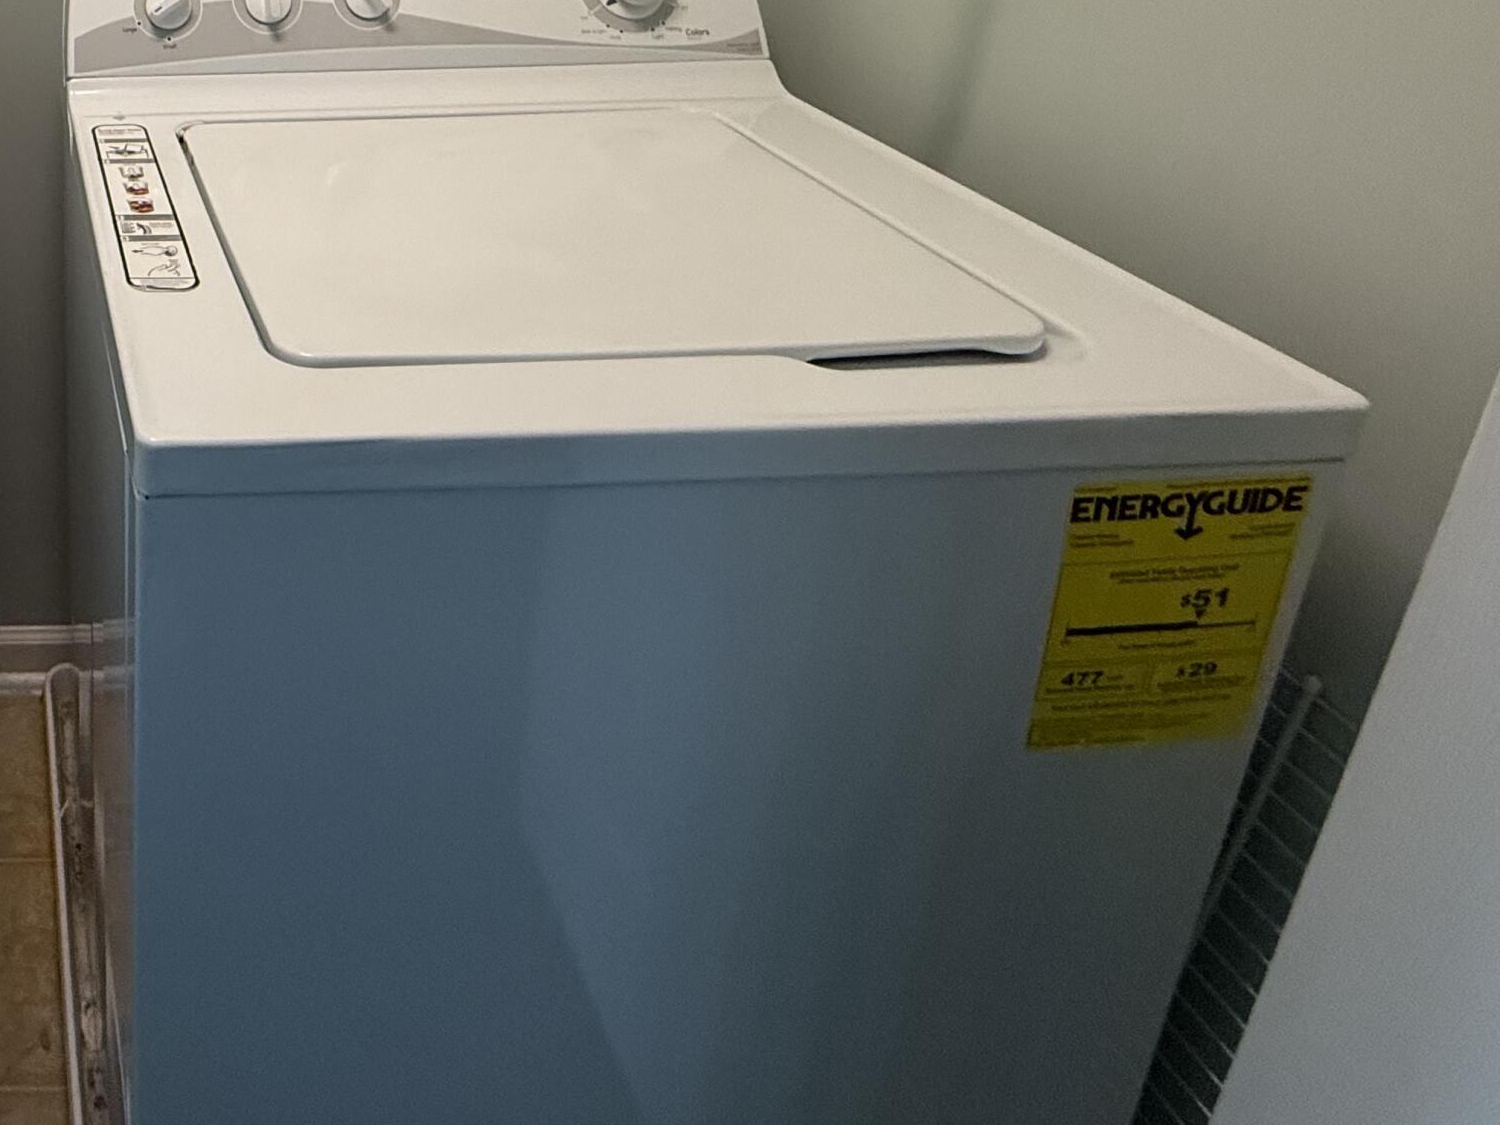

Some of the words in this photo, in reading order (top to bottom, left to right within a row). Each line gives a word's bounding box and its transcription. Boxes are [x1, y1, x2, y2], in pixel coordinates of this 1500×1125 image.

[685, 27, 711, 37] Colors
[1069, 485, 1309, 525] ENERGYGUIDE
[1180, 586, 1230, 609] $51
[1060, 670, 1105, 686] 477
